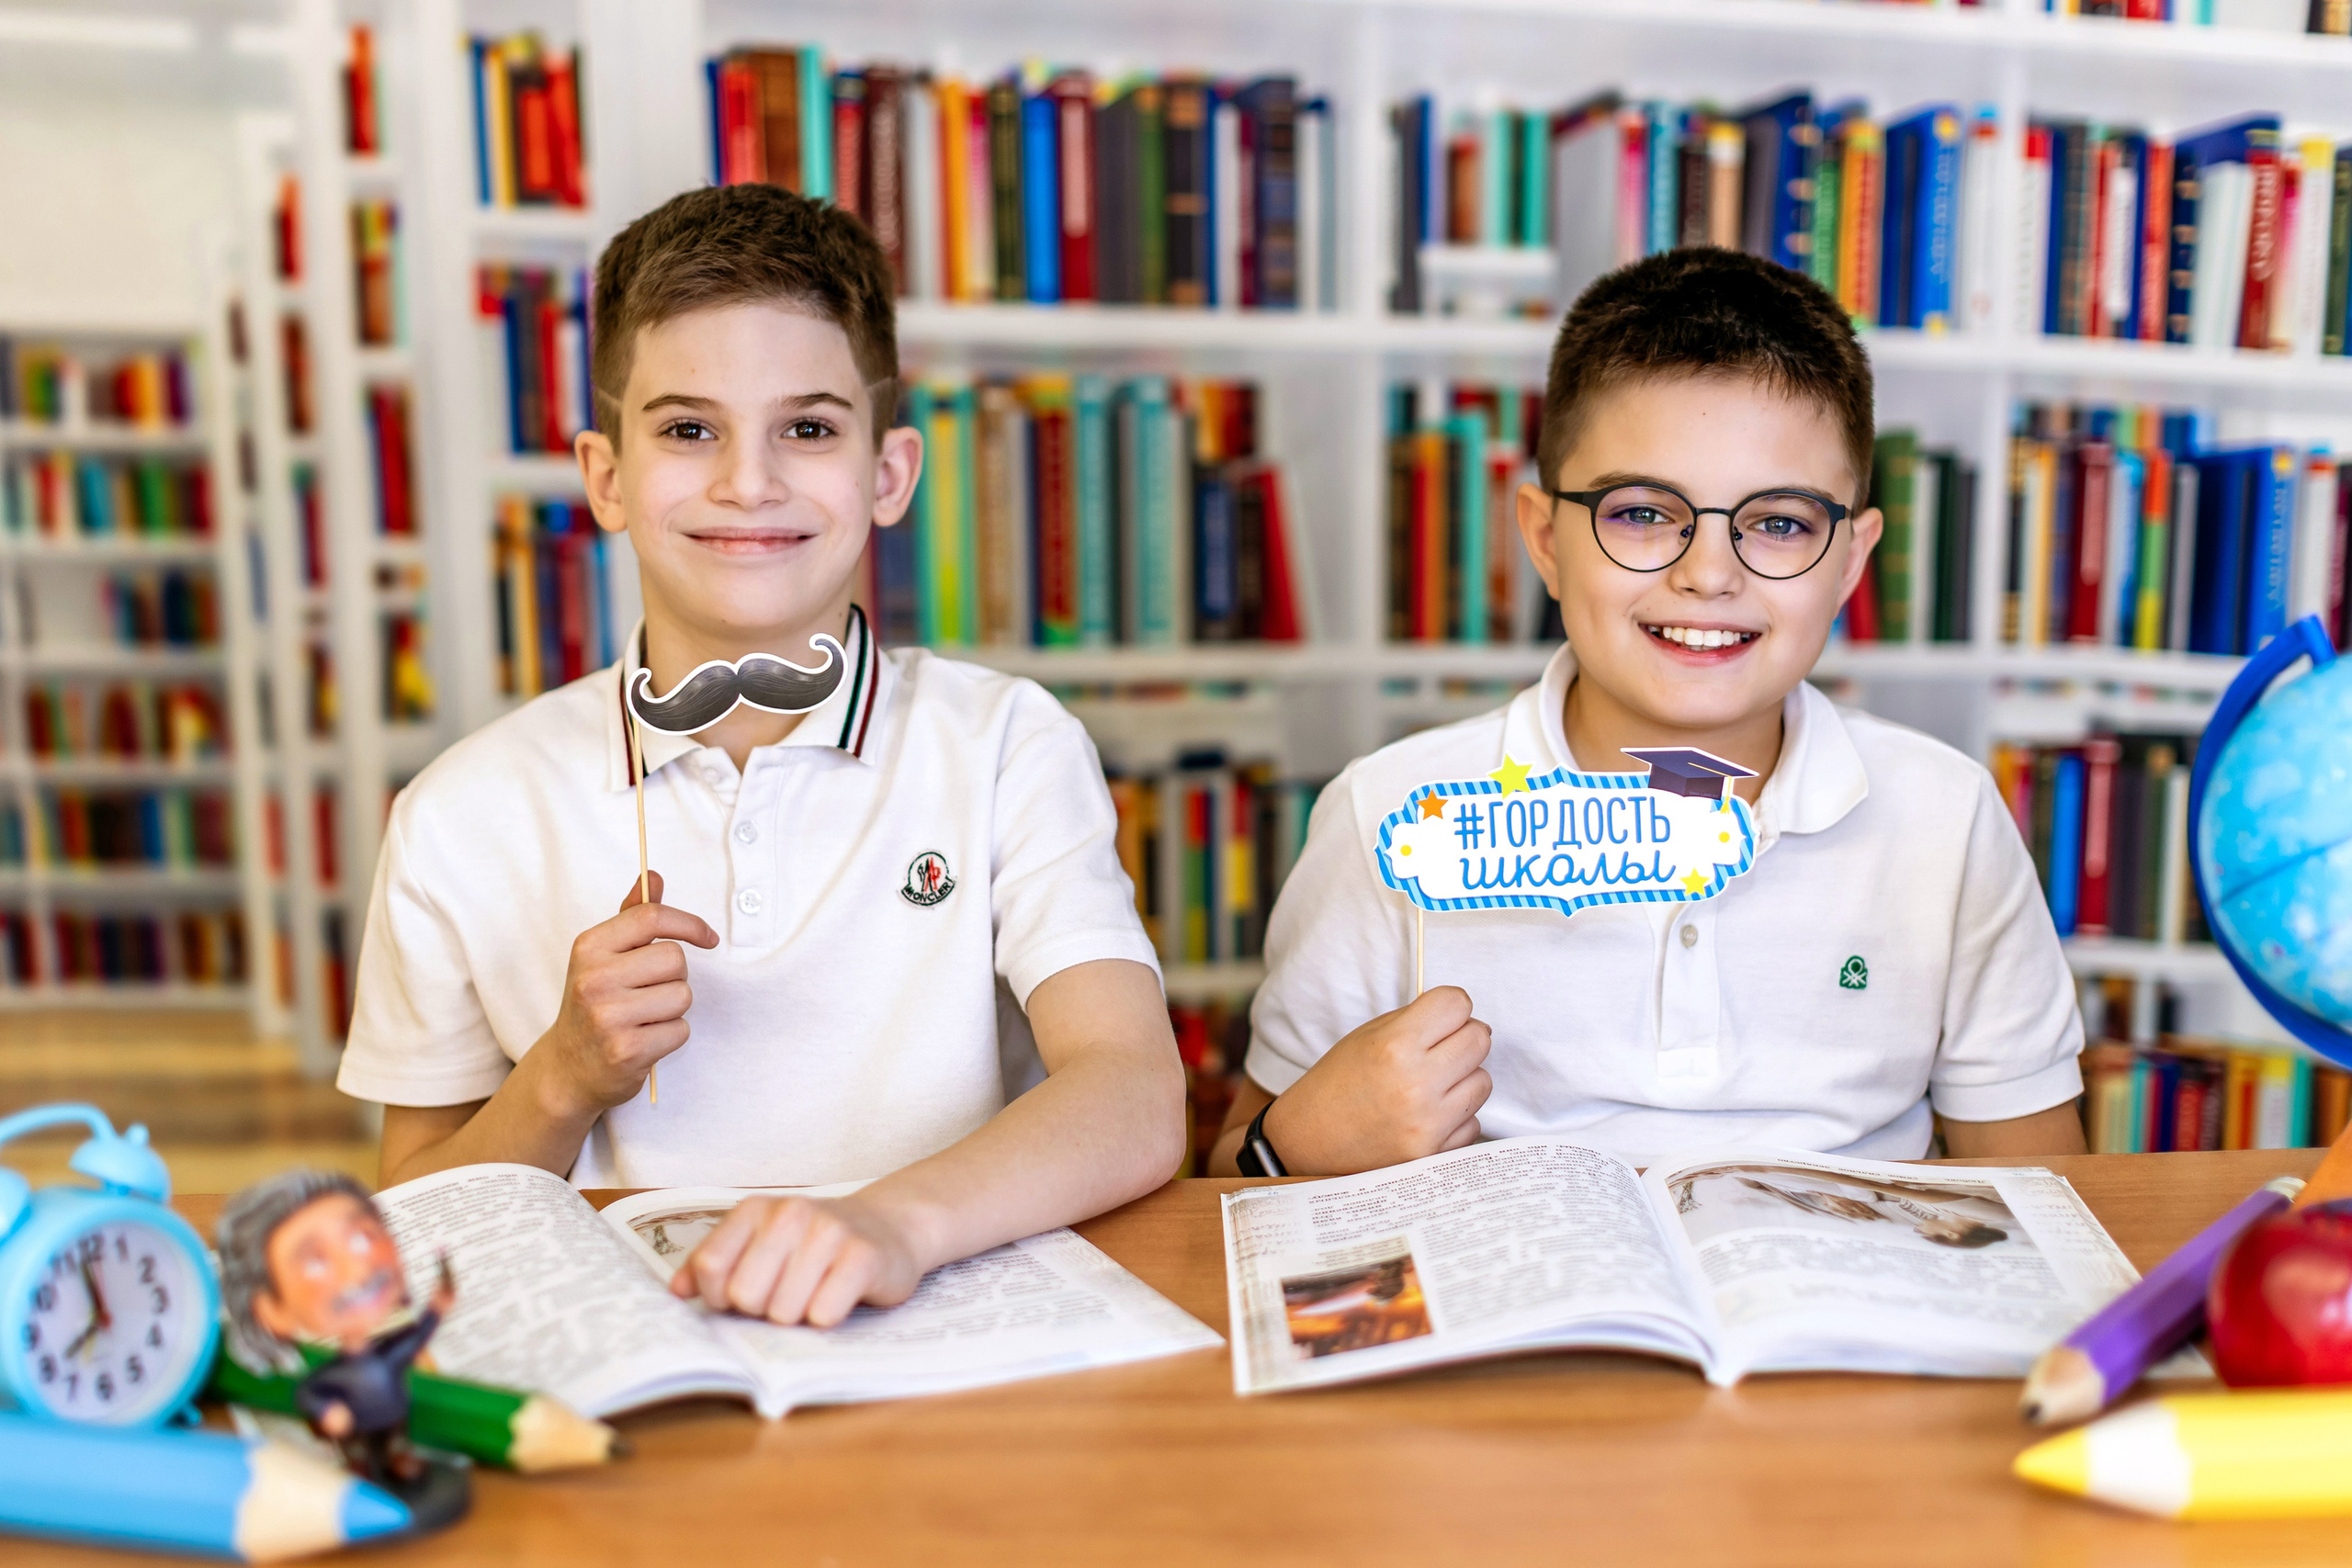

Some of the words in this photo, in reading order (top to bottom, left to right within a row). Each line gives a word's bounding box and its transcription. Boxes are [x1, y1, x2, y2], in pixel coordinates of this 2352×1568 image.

[1453, 796, 1670, 850] #ГОРДОСТЬ
[1459, 850, 1677, 890] школы
[904, 882, 952, 902] MONCLER
[141, 1255, 155, 1283] 2
[153, 1286, 169, 1314] 3
[147, 1324, 163, 1348] 4
[40, 1355, 58, 1383] 8
[127, 1356, 143, 1382] 5
[64, 1374, 79, 1402] 7
[97, 1373, 114, 1401] 6
